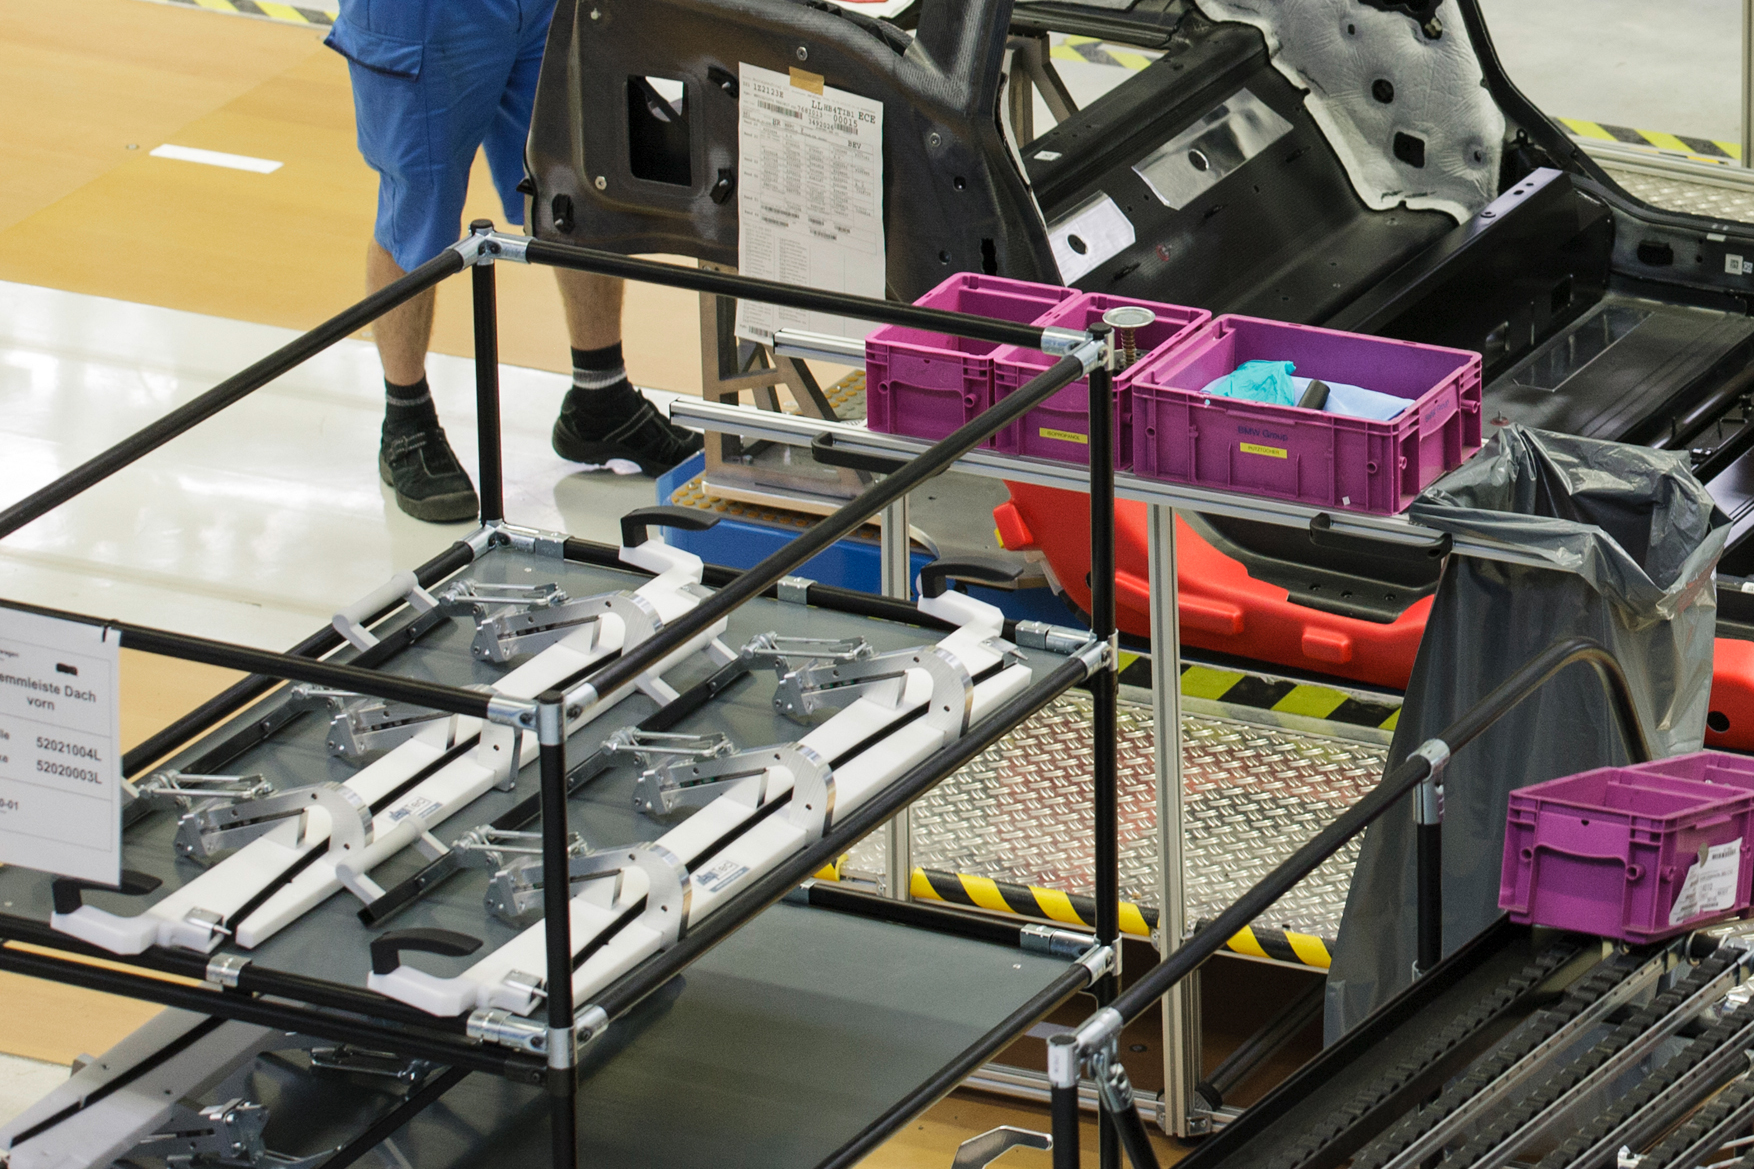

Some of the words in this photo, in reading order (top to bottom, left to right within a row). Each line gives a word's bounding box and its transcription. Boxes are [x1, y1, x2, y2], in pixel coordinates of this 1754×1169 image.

[1238, 425, 1260, 436] BMW
[1262, 429, 1288, 442] Group
[26, 695, 55, 711] vorn
[64, 685, 97, 703] Dach
[36, 736, 102, 762] 52021004L
[36, 760, 103, 785] 52020003L
